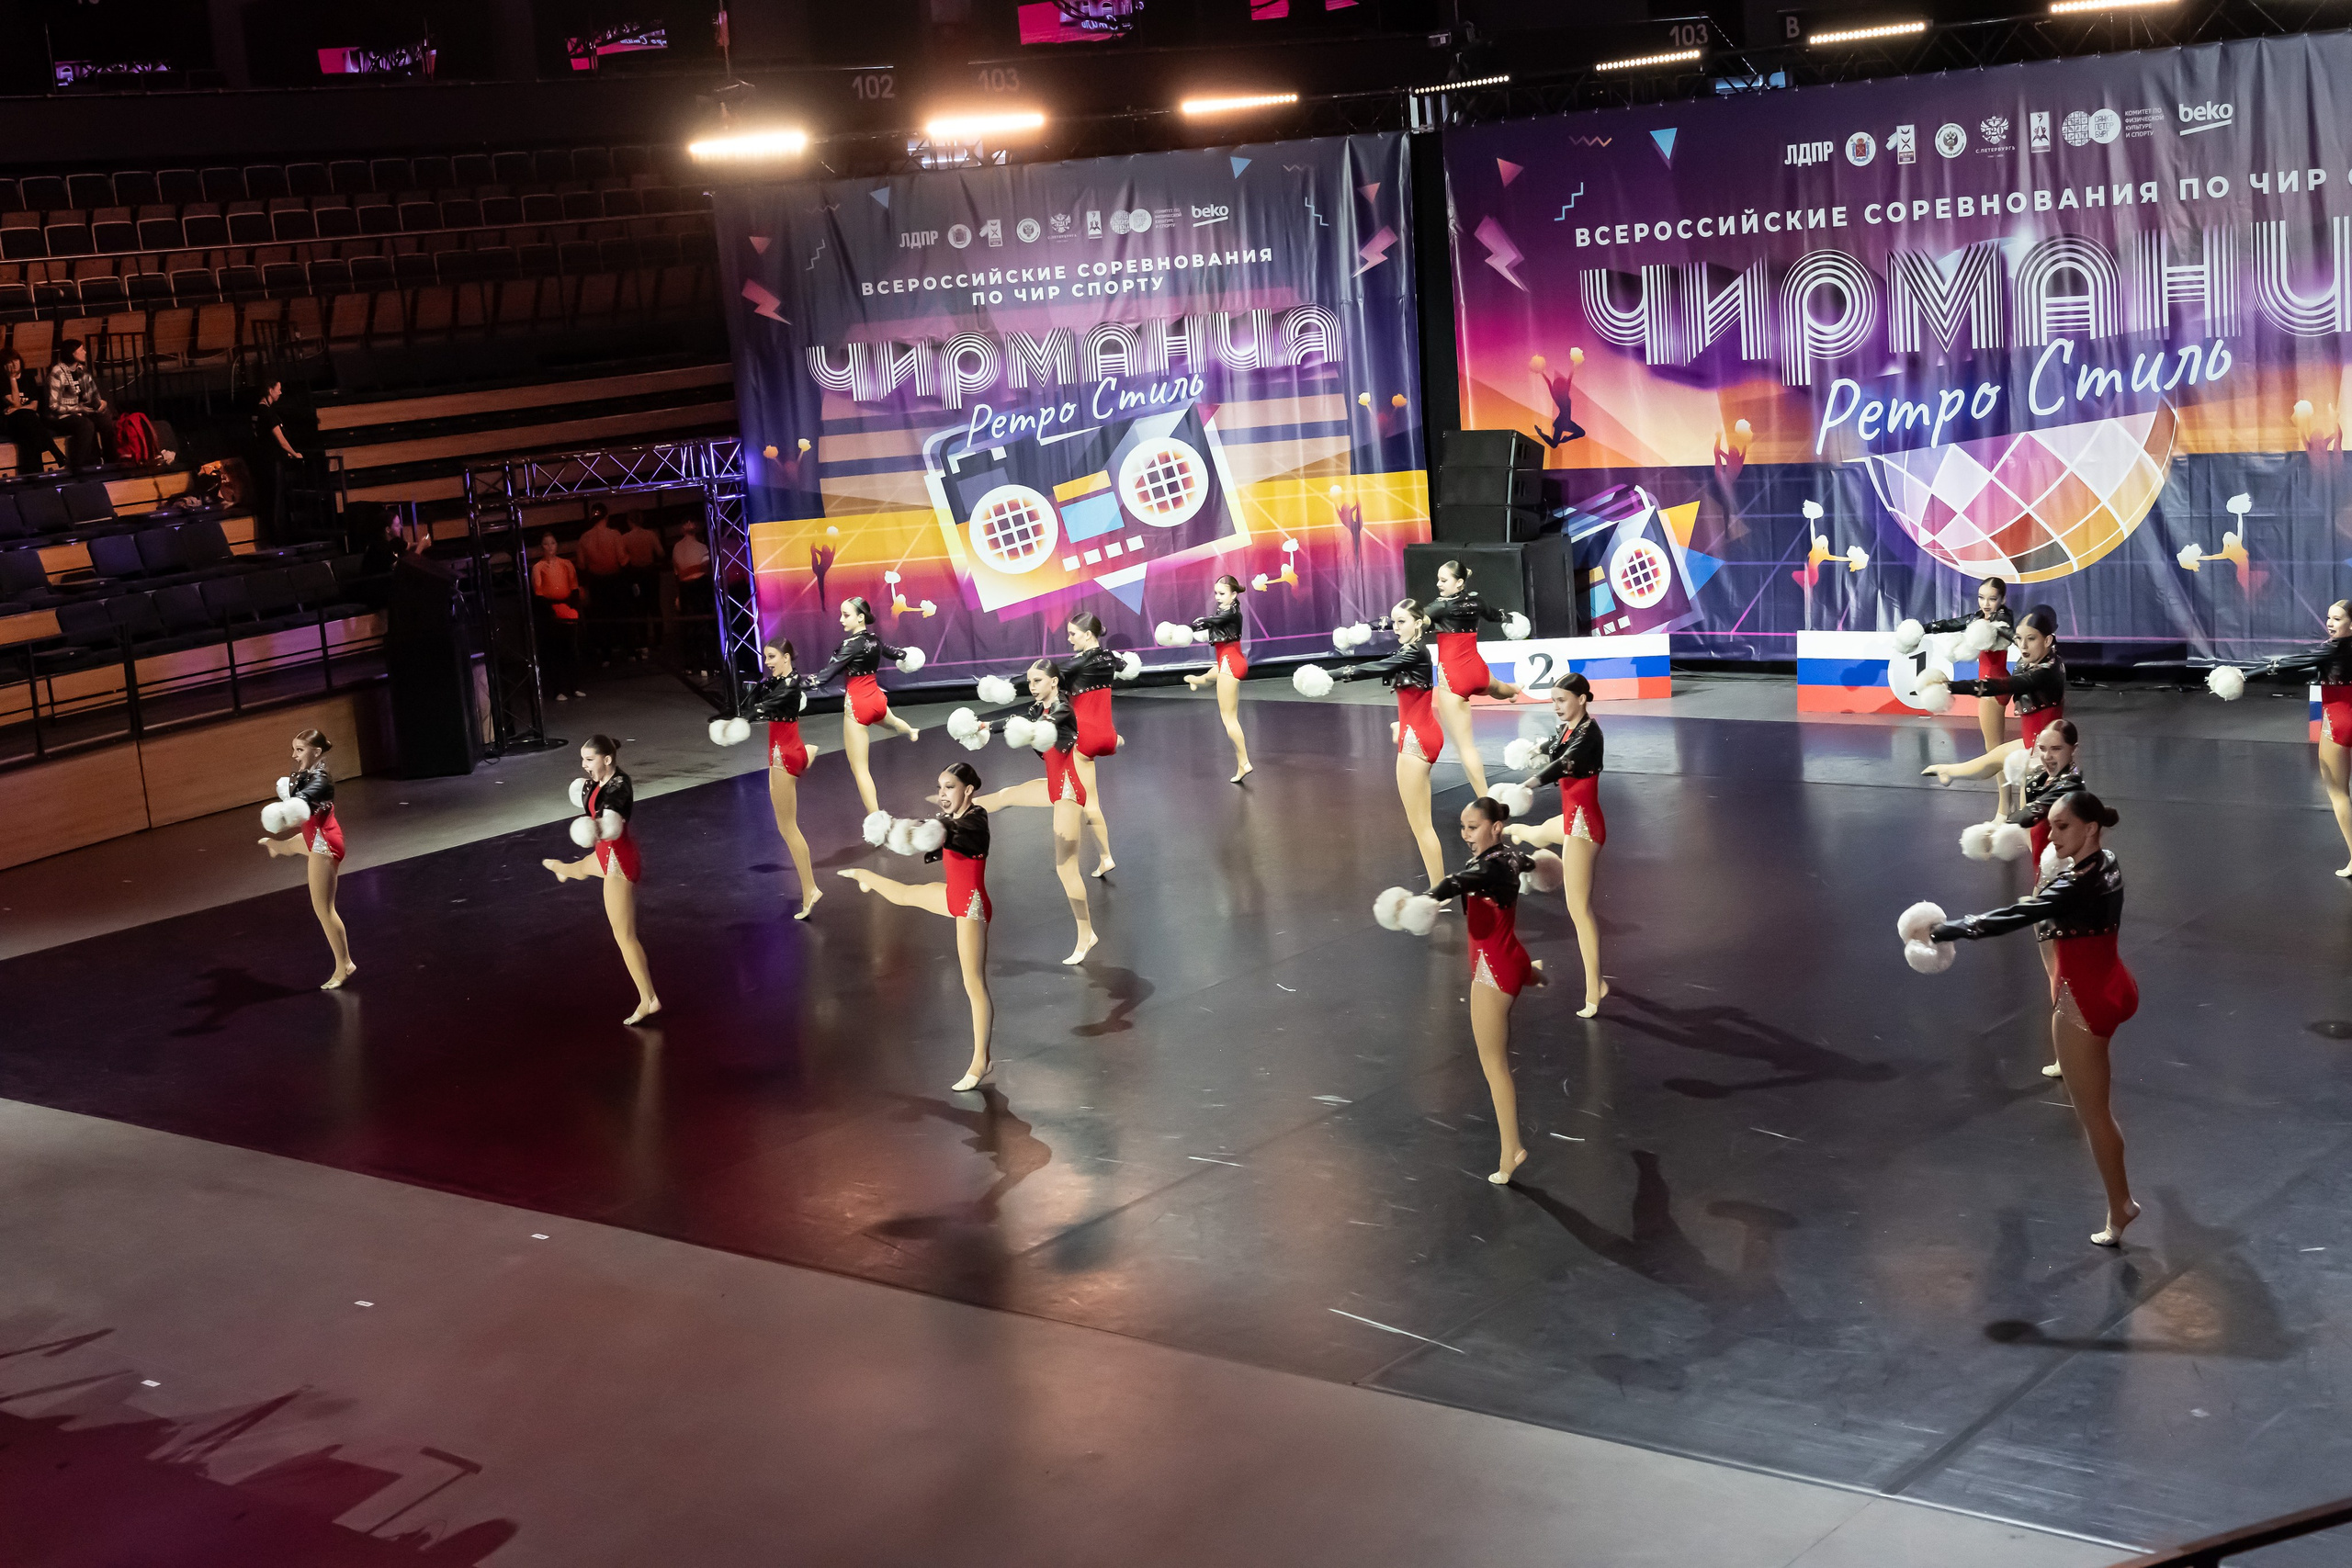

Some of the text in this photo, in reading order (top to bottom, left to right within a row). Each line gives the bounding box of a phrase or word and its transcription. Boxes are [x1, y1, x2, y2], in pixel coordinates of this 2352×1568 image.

[1668, 24, 1709, 47] 103
[852, 73, 896, 99] 102
[978, 67, 1020, 93] 103
[2178, 100, 2233, 123] beko
[1784, 141, 1834, 167] ЛДПР
[1191, 204, 1229, 220] beko
[1575, 206, 1848, 247] ВСЕРОССИЙСКИЕ
[1864, 181, 2158, 225] СОРЕВНОВАНИЯ
[2179, 175, 2230, 201] ПО
[2249, 168, 2327, 196] ЧИР
[899, 230, 939, 249] ЛДПР
[861, 247, 1272, 296] ВСЕРОССИЙСКИЕ СОРЕВНОВАНИЯ
[971, 276, 1164, 306] ПО ЧИР СПОРТУ
[1815, 337, 2233, 455] Ретро Стиль
[967, 374, 1204, 448] Ретро Стиль
[1528, 652, 1555, 690] 2
[1908, 650, 1927, 696] 1
